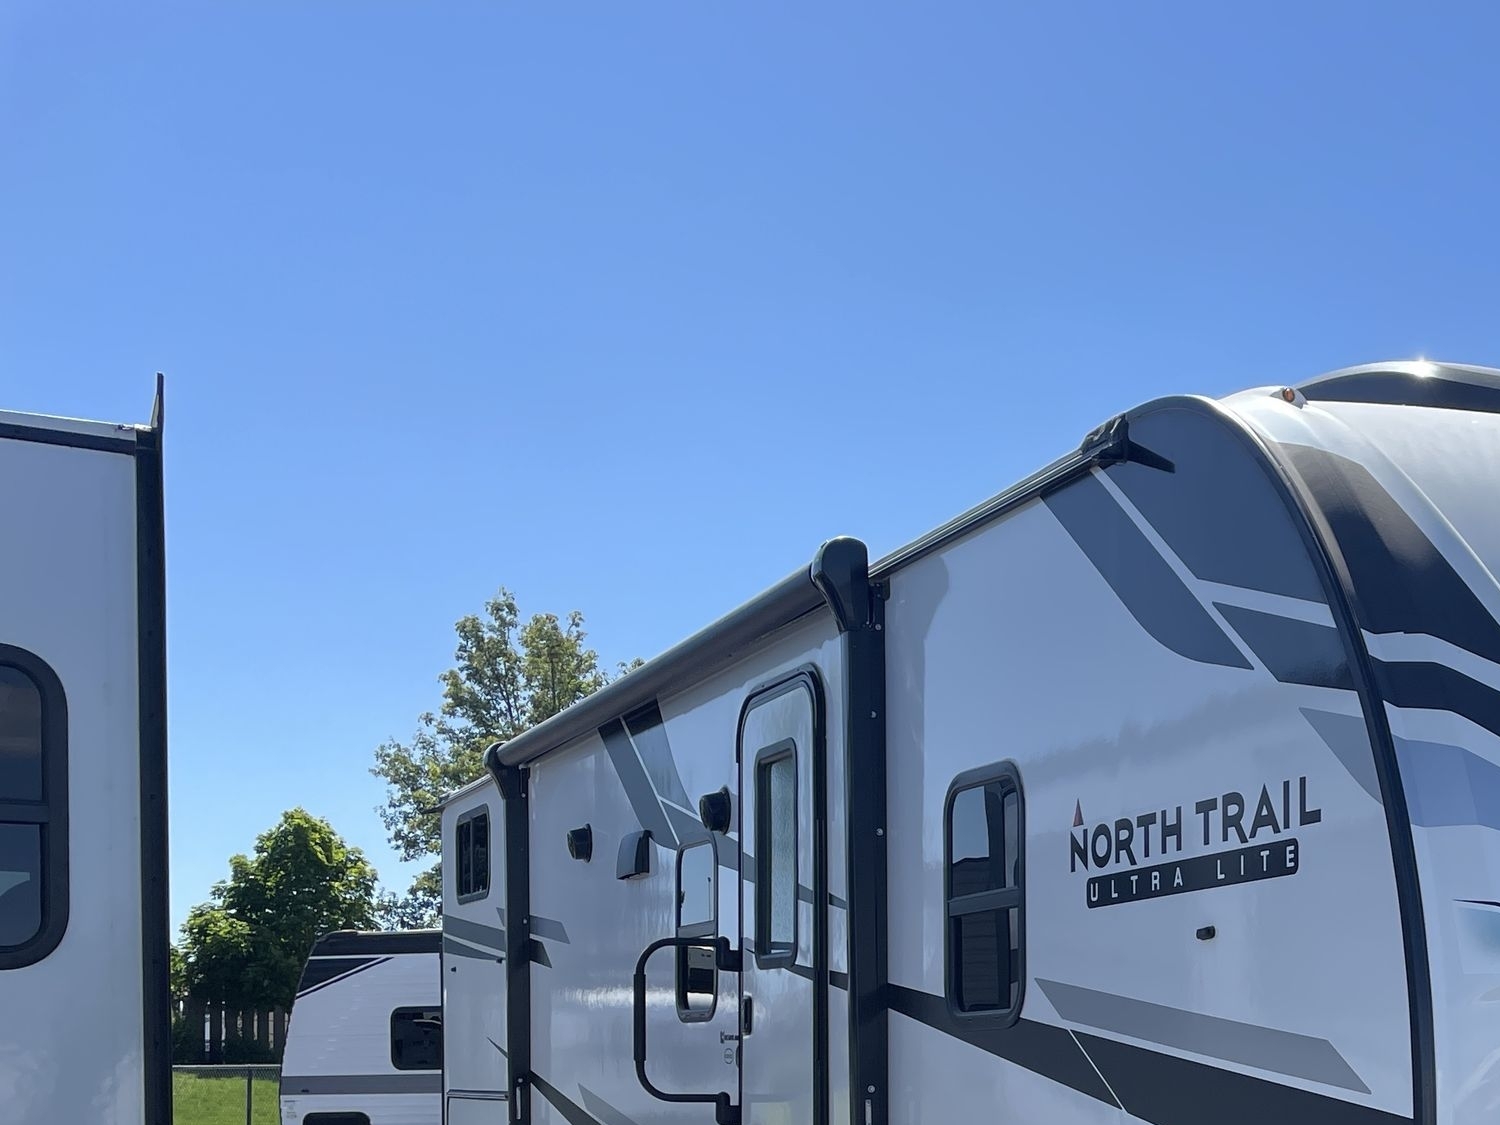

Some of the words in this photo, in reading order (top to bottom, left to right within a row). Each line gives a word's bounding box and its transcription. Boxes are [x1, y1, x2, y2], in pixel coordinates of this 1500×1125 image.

[1070, 806, 1182, 873] NORTH
[1195, 776, 1322, 846] TRAIL
[1090, 867, 1184, 902] ULTRA
[1216, 845, 1296, 880] LITE
